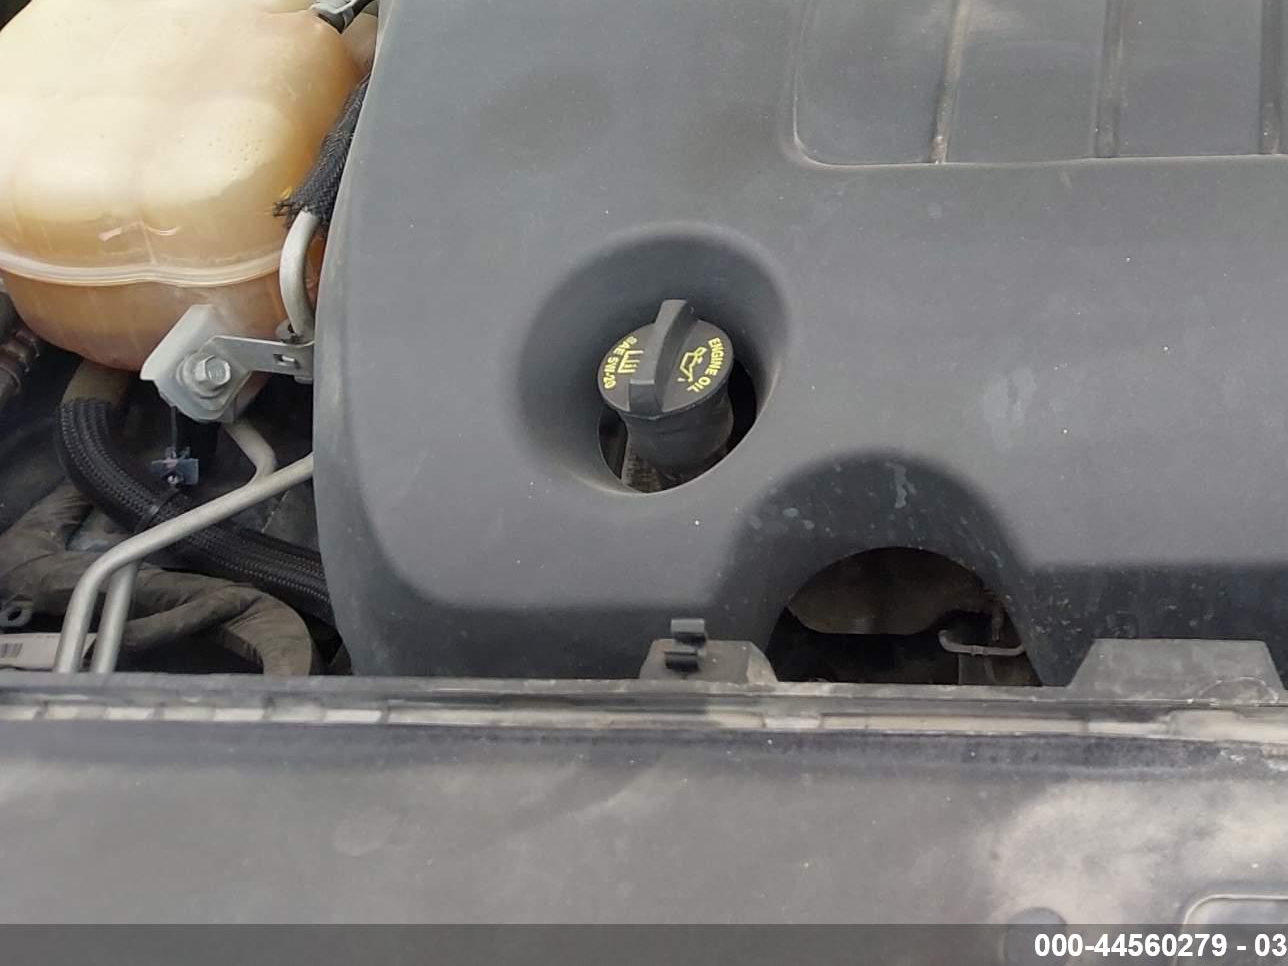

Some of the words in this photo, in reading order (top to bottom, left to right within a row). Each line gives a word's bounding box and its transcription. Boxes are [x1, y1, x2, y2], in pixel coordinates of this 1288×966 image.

[612, 336, 638, 356] SAE
[704, 337, 725, 377] ENGINE
[602, 355, 620, 390] 5W-20
[686, 376, 712, 392] OIL
